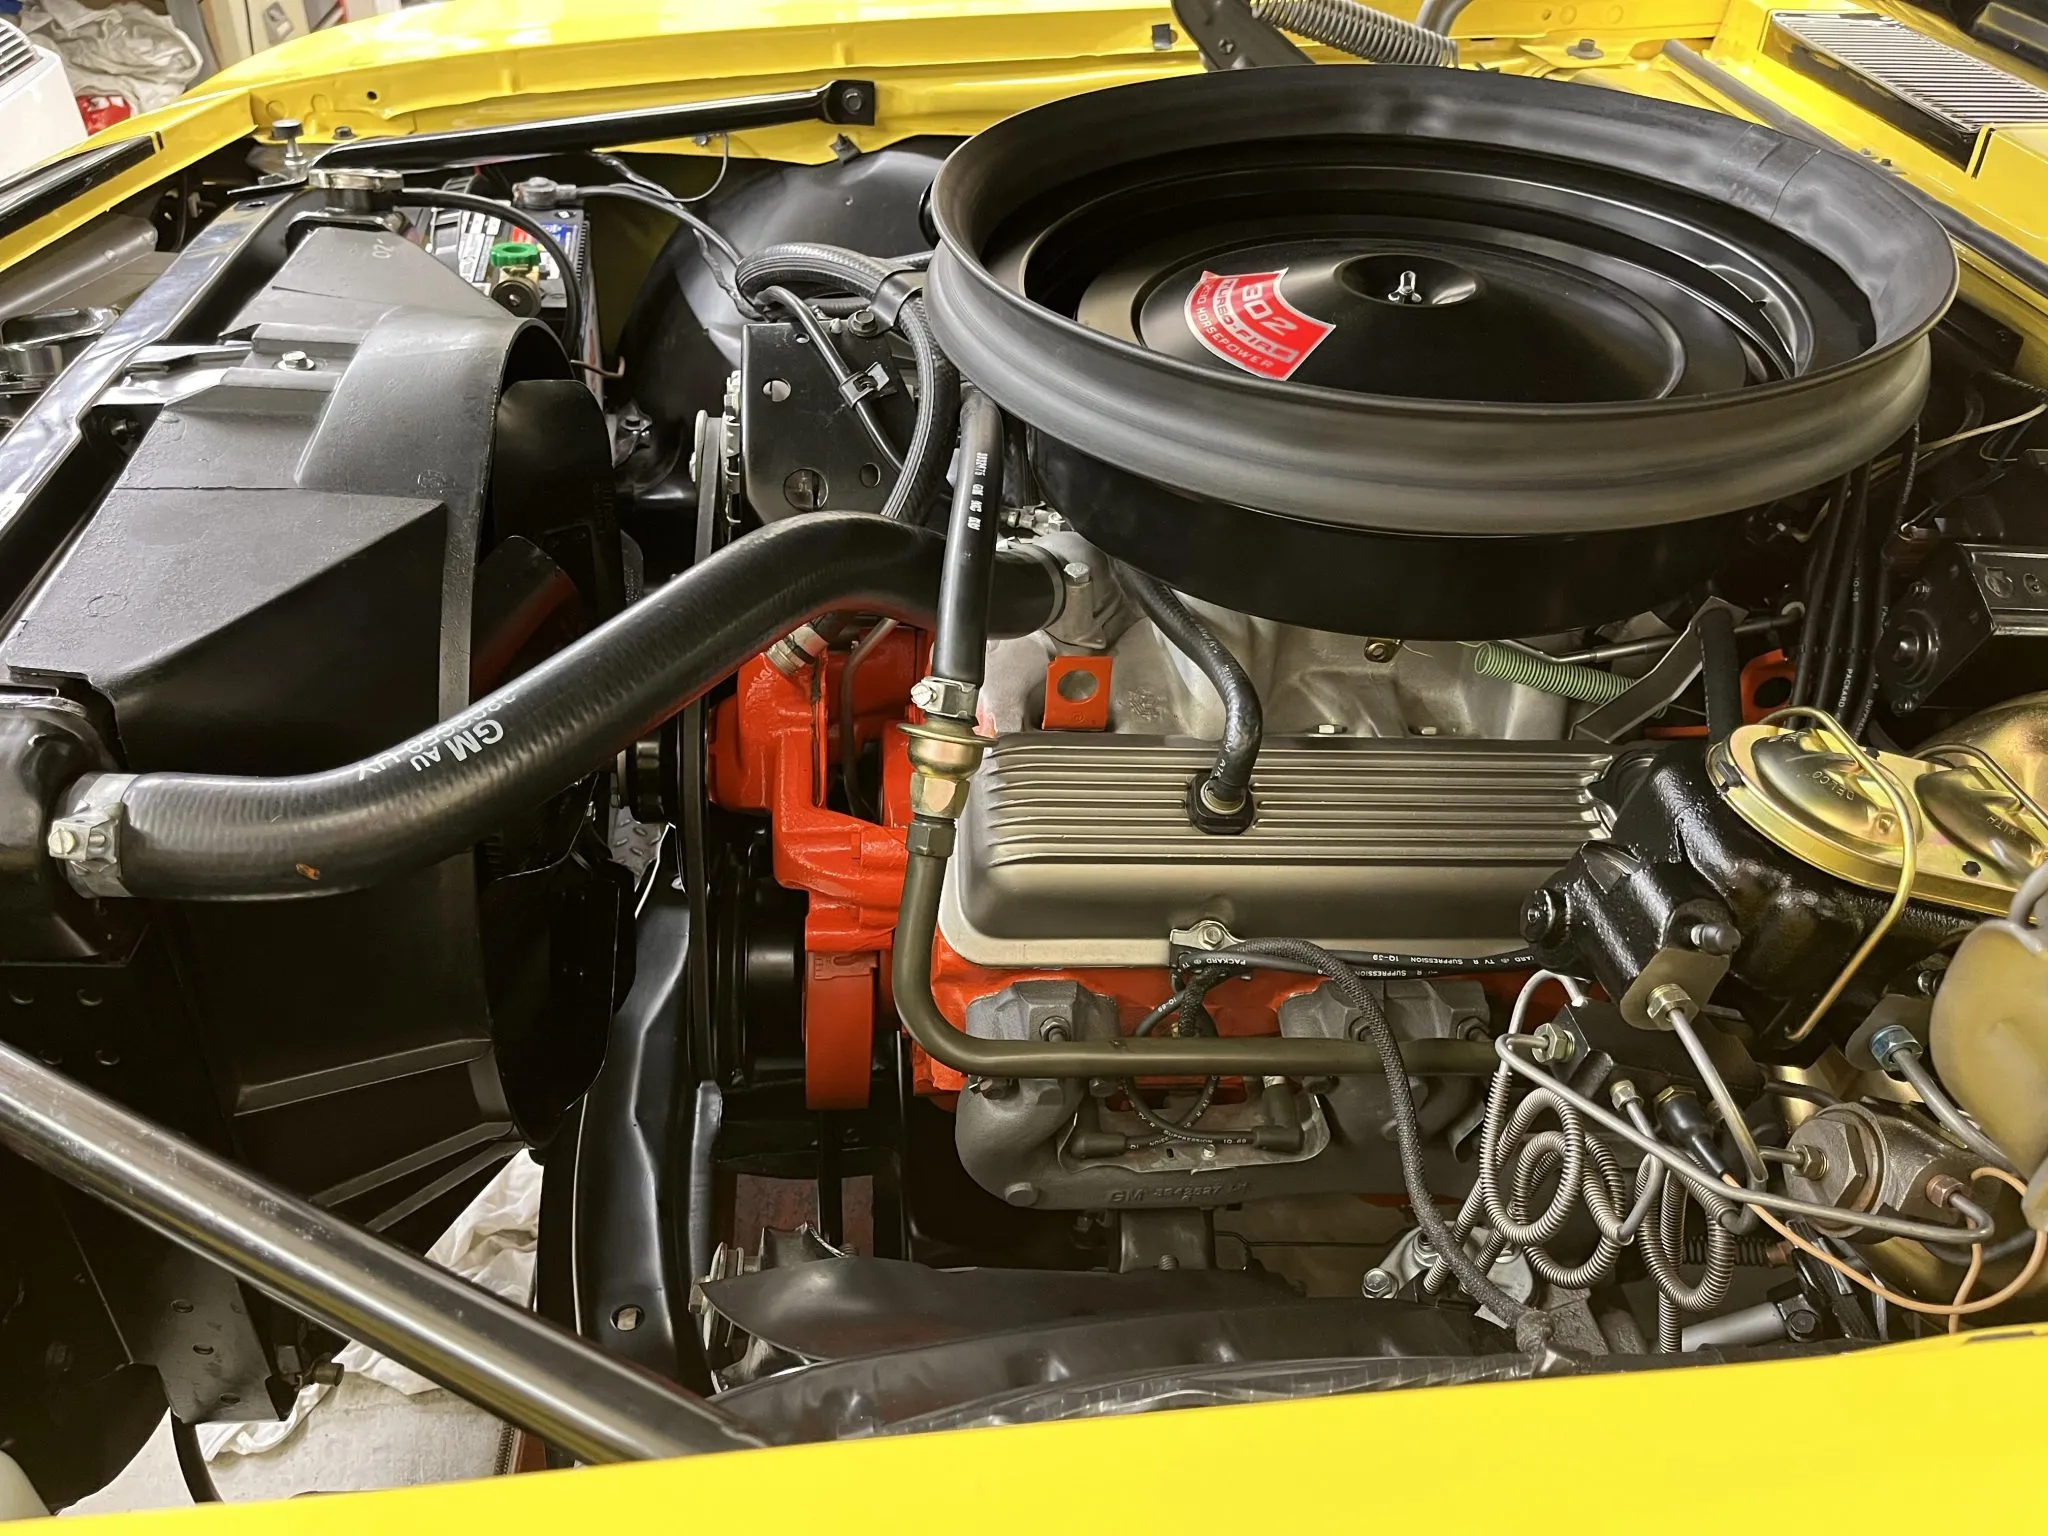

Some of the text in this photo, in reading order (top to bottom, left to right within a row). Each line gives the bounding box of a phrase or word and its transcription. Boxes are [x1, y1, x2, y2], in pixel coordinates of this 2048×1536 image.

[1241, 283, 1298, 337] 302
[1195, 306, 1274, 369] HORSEPOWER
[1837, 668, 1853, 708] PACKARD
[409, 719, 505, 772] GM AU
[1812, 770, 1855, 802] DELCO
[1205, 958, 1246, 967] PACKARD
[1410, 956, 1464, 965] SUPPRESSION
[1109, 1188, 1144, 1202] GM
